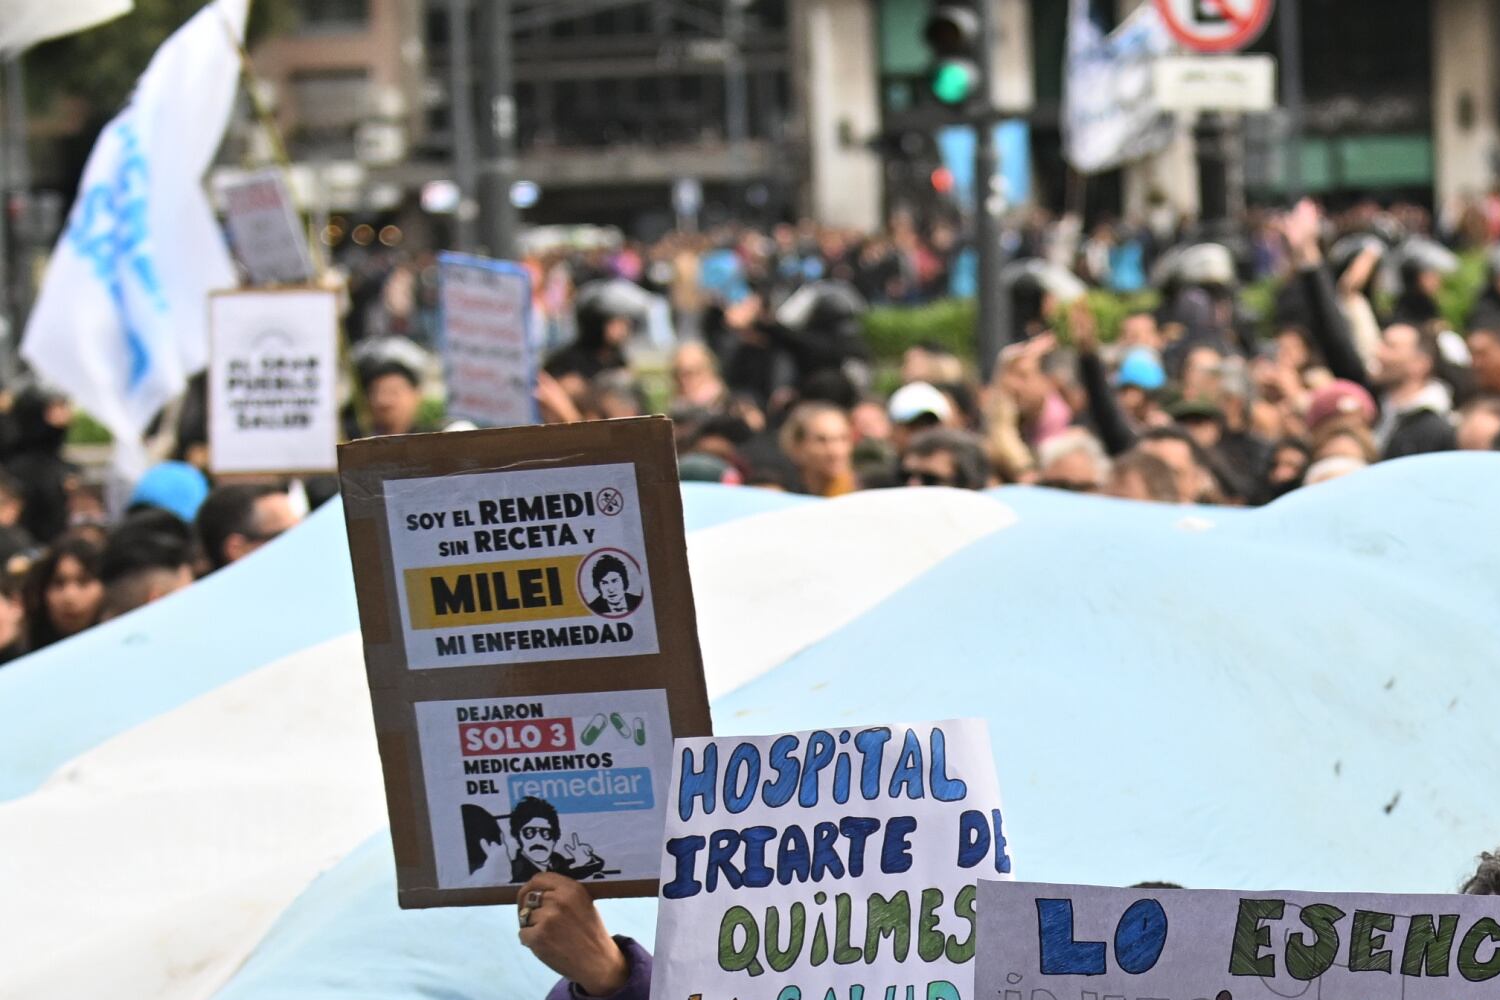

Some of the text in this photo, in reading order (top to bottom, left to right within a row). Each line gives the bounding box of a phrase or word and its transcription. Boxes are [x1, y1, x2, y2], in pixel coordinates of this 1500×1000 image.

[406, 512, 446, 531] SOY
[453, 510, 475, 527] EL
[438, 523, 595, 557] SIN RECETA Y
[430, 567, 563, 616] MILEI
[435, 622, 633, 656] MI ENFERMEDAD
[456, 703, 544, 722] DEJARON
[465, 723, 568, 751] SOLO 3
[463, 752, 613, 775] MEDICAMENTOS
[467, 769, 642, 799] DEL remediar
[662, 815, 918, 899] IRIARTE
[1035, 898, 1168, 976] LO
